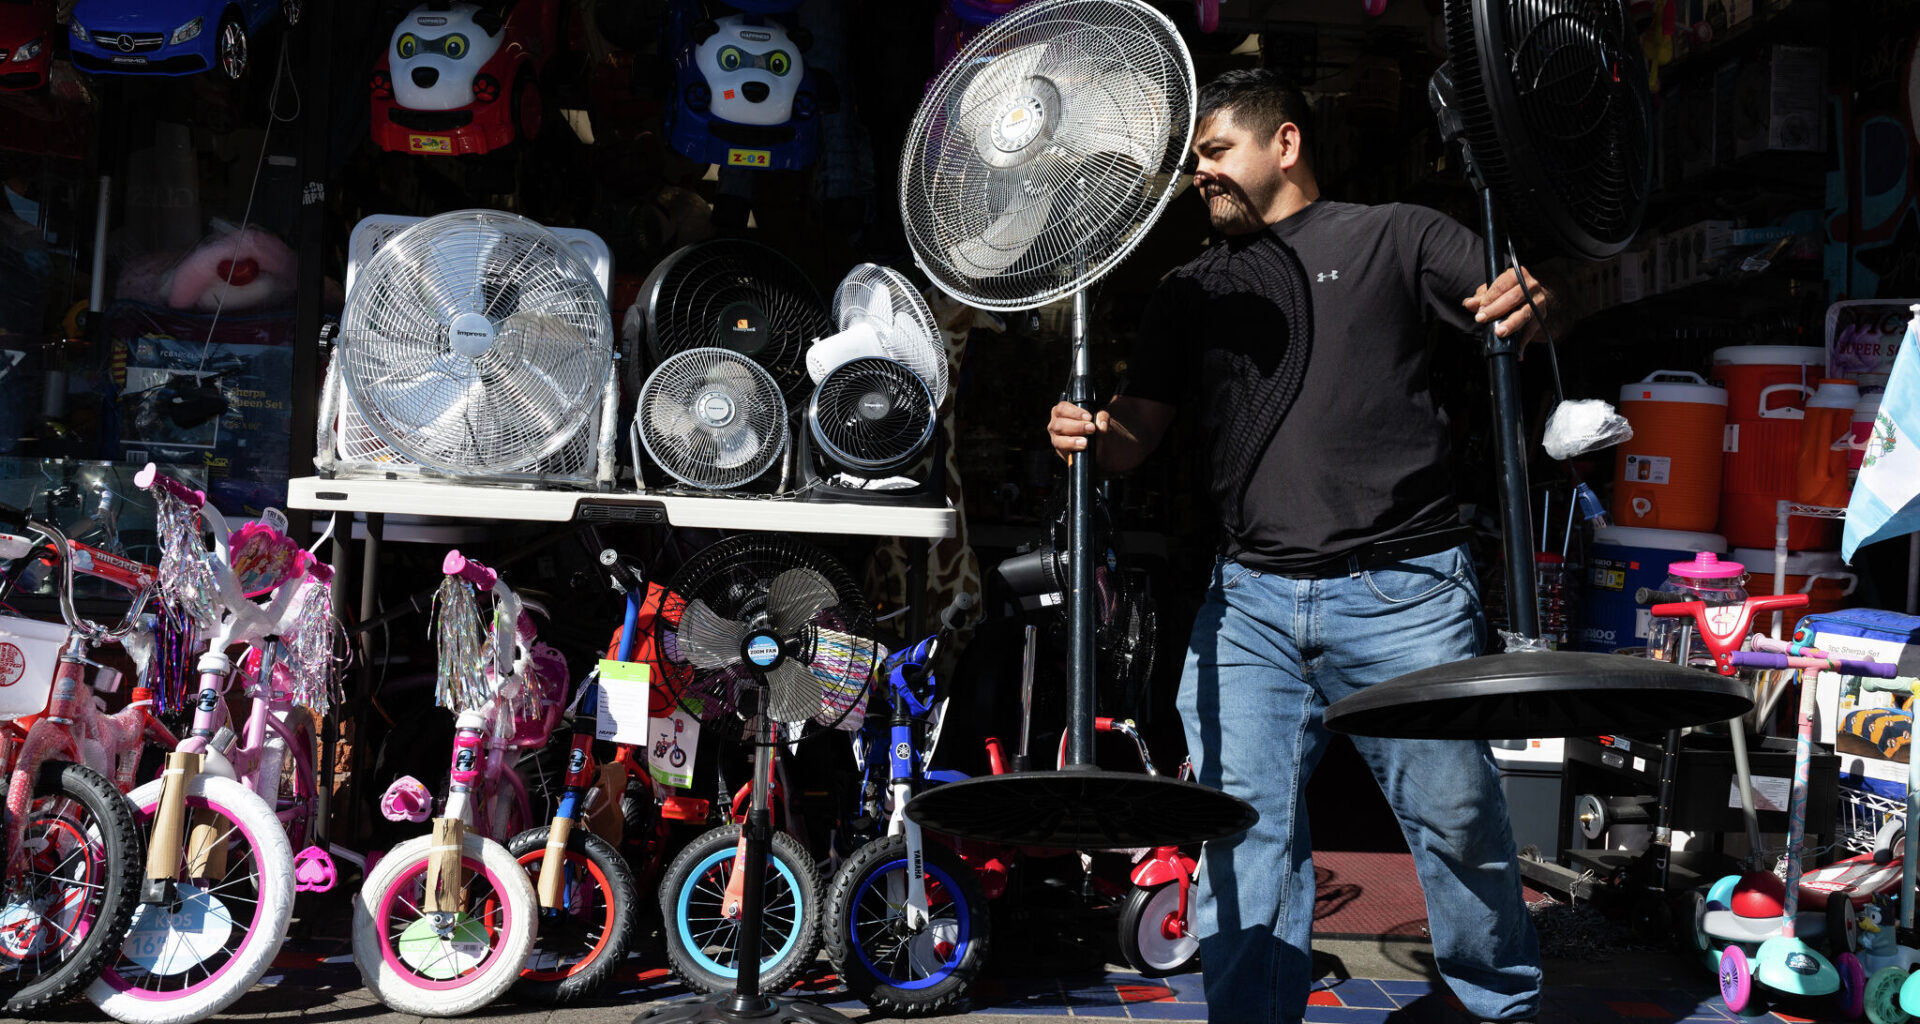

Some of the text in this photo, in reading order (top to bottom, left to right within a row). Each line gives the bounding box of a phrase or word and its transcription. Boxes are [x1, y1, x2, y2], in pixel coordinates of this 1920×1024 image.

[733, 154, 765, 164] Z-02
[265, 400, 283, 410] Set
[1868, 649, 1880, 657] Set
[913, 850, 922, 880] YAMAHA
